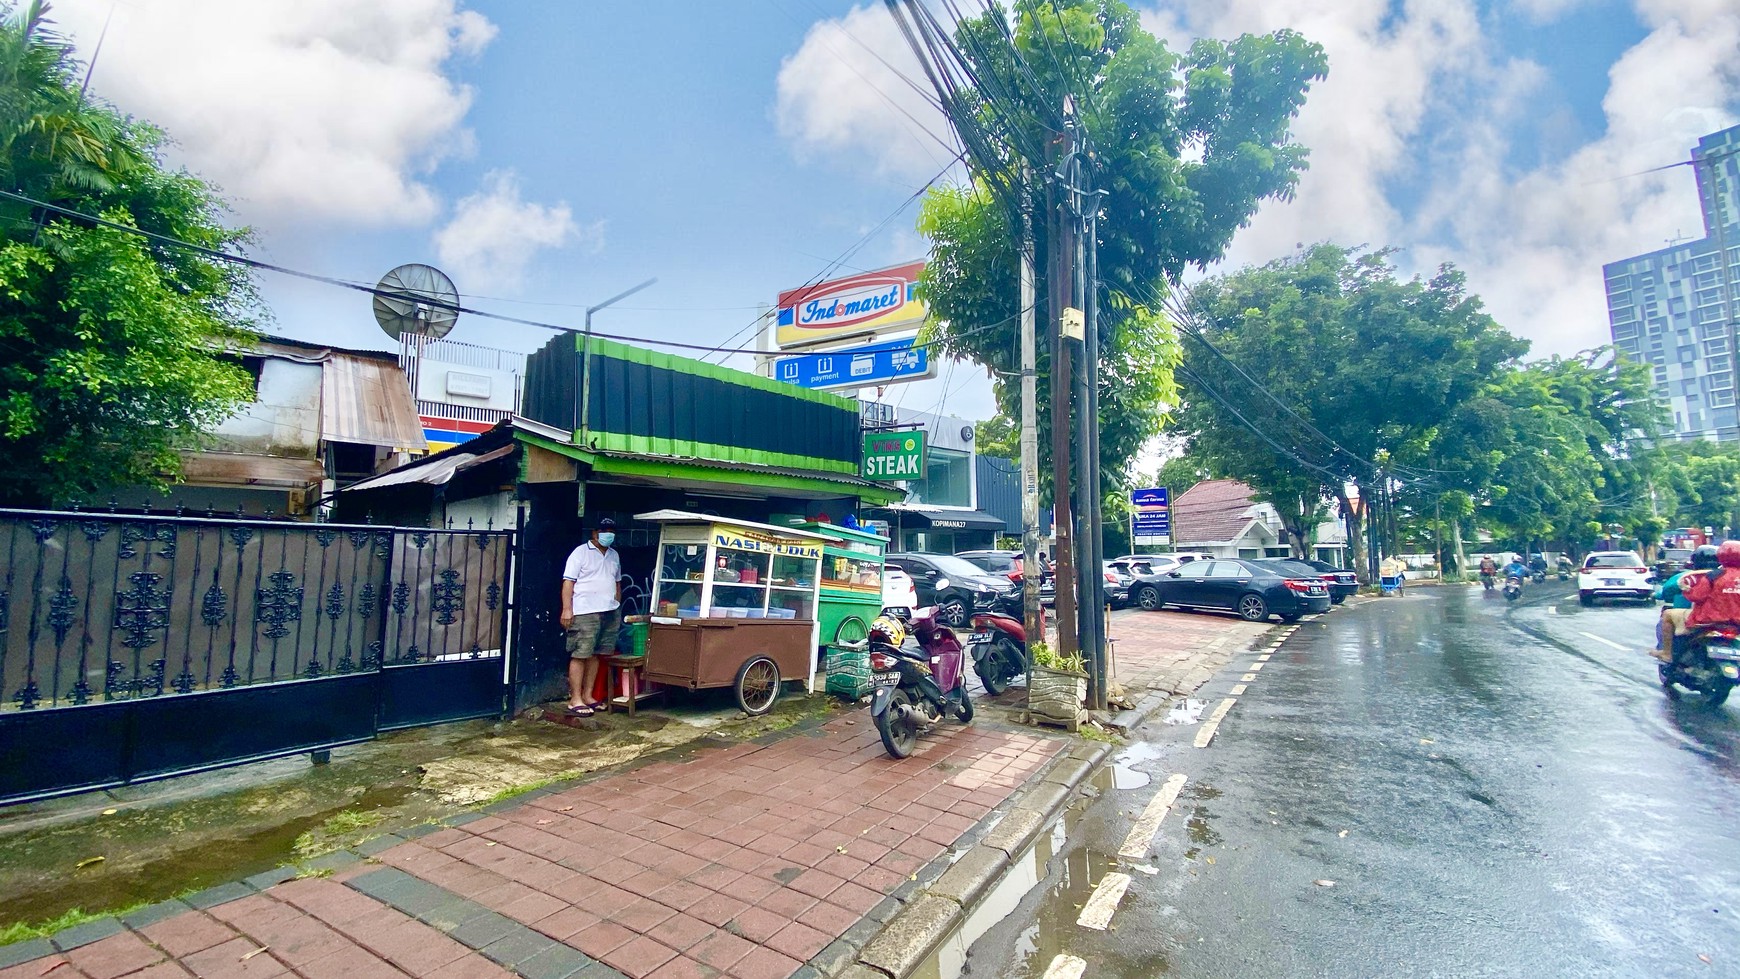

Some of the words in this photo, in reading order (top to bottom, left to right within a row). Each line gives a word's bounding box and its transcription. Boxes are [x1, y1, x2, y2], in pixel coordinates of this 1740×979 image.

[802, 285, 898, 323] Indomaret
[810, 372, 839, 384] payment
[854, 366, 872, 375] DEBIT
[866, 454, 919, 476] STEAK
[931, 520, 966, 528] KOPIMANA27
[716, 535, 760, 551] NASI
[777, 544, 820, 558] UDUK
